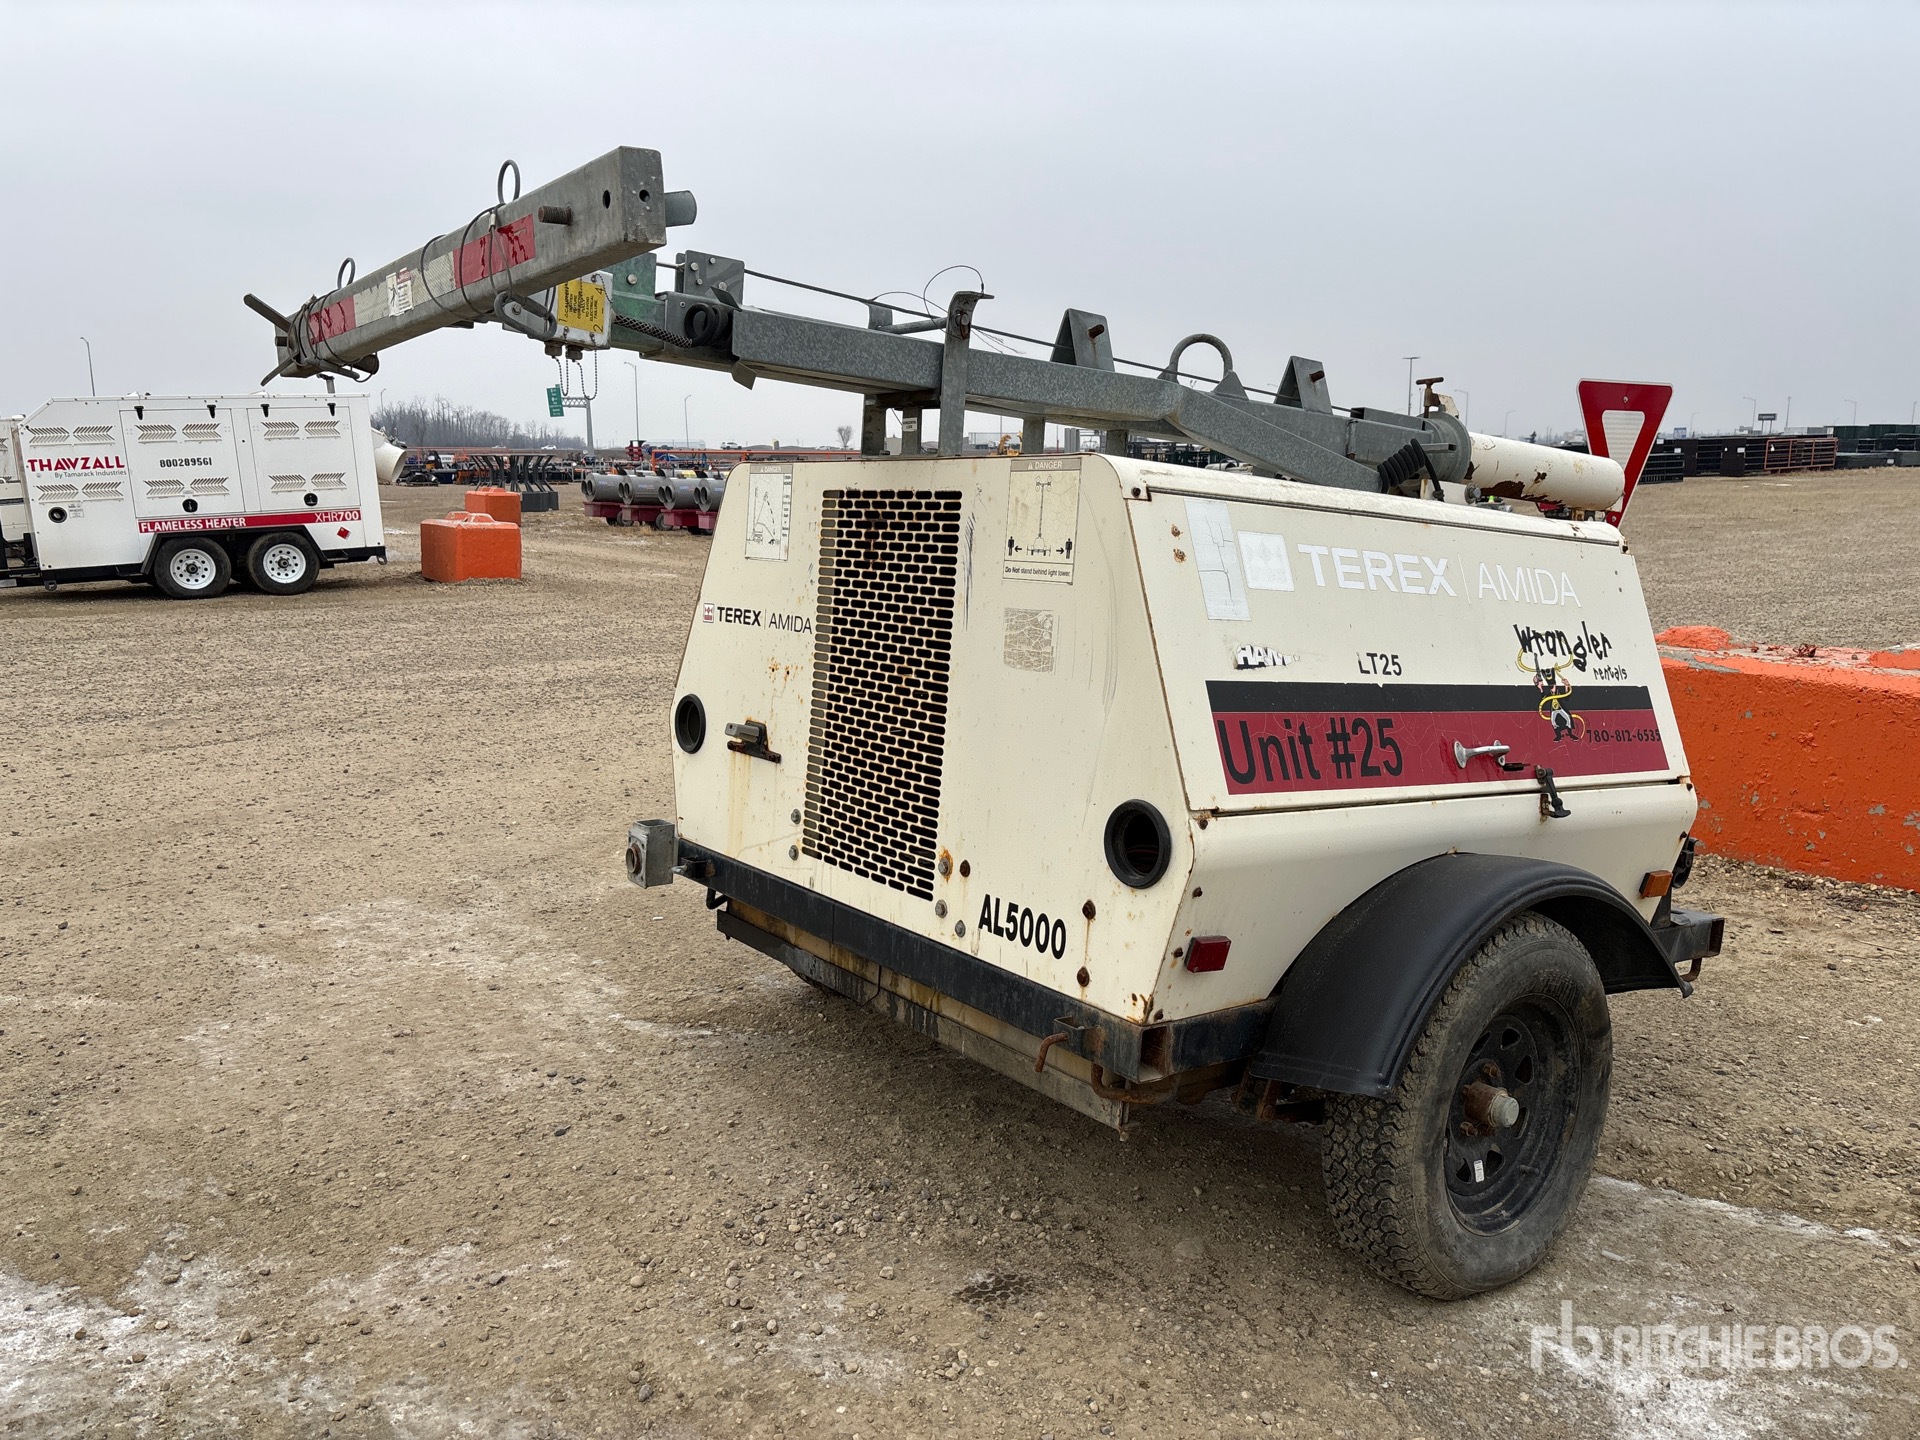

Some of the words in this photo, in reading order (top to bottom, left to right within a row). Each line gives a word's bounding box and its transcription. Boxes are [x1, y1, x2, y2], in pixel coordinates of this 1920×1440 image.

[27, 456, 125, 472] THAWZALL
[160, 457, 212, 468] 800289561
[1034, 461, 1062, 470] DANGER
[314, 510, 360, 522] XHR700
[140, 520, 204, 532] FLAMELESS
[205, 518, 246, 528] HEATER
[1297, 543, 1458, 597] TEREX
[1478, 562, 1582, 608] AMIDA
[717, 606, 762, 626] TEREX
[768, 612, 812, 634] AMIDA
[1356, 652, 1402, 676] LT25
[1593, 665, 1628, 682] rentals
[1586, 729, 1662, 743] 780-812-6535
[1216, 718, 1322, 785] Unit
[1326, 717, 1402, 780] #25
[978, 893, 1066, 960] AL5000
